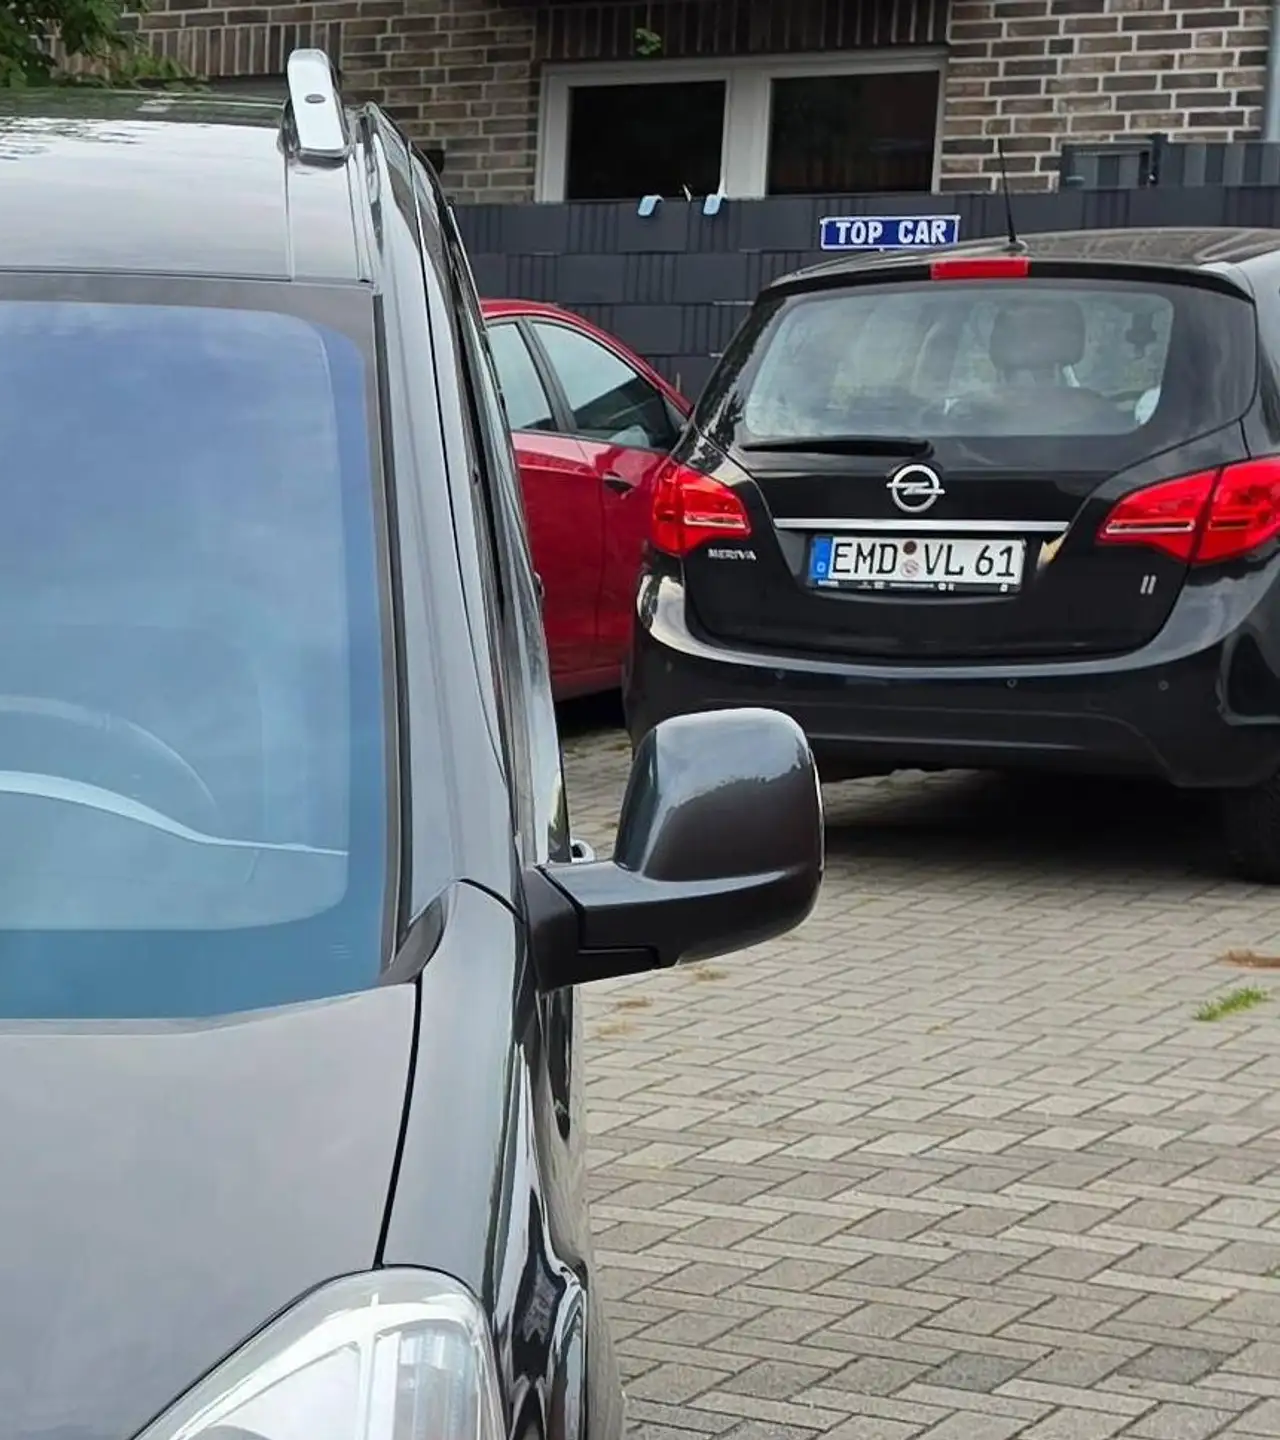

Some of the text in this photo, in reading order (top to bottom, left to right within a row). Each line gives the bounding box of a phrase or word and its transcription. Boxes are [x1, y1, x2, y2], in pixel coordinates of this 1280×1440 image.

[835, 220, 947, 244] TOP CAR
[832, 543, 1015, 577] EMD VL 61
